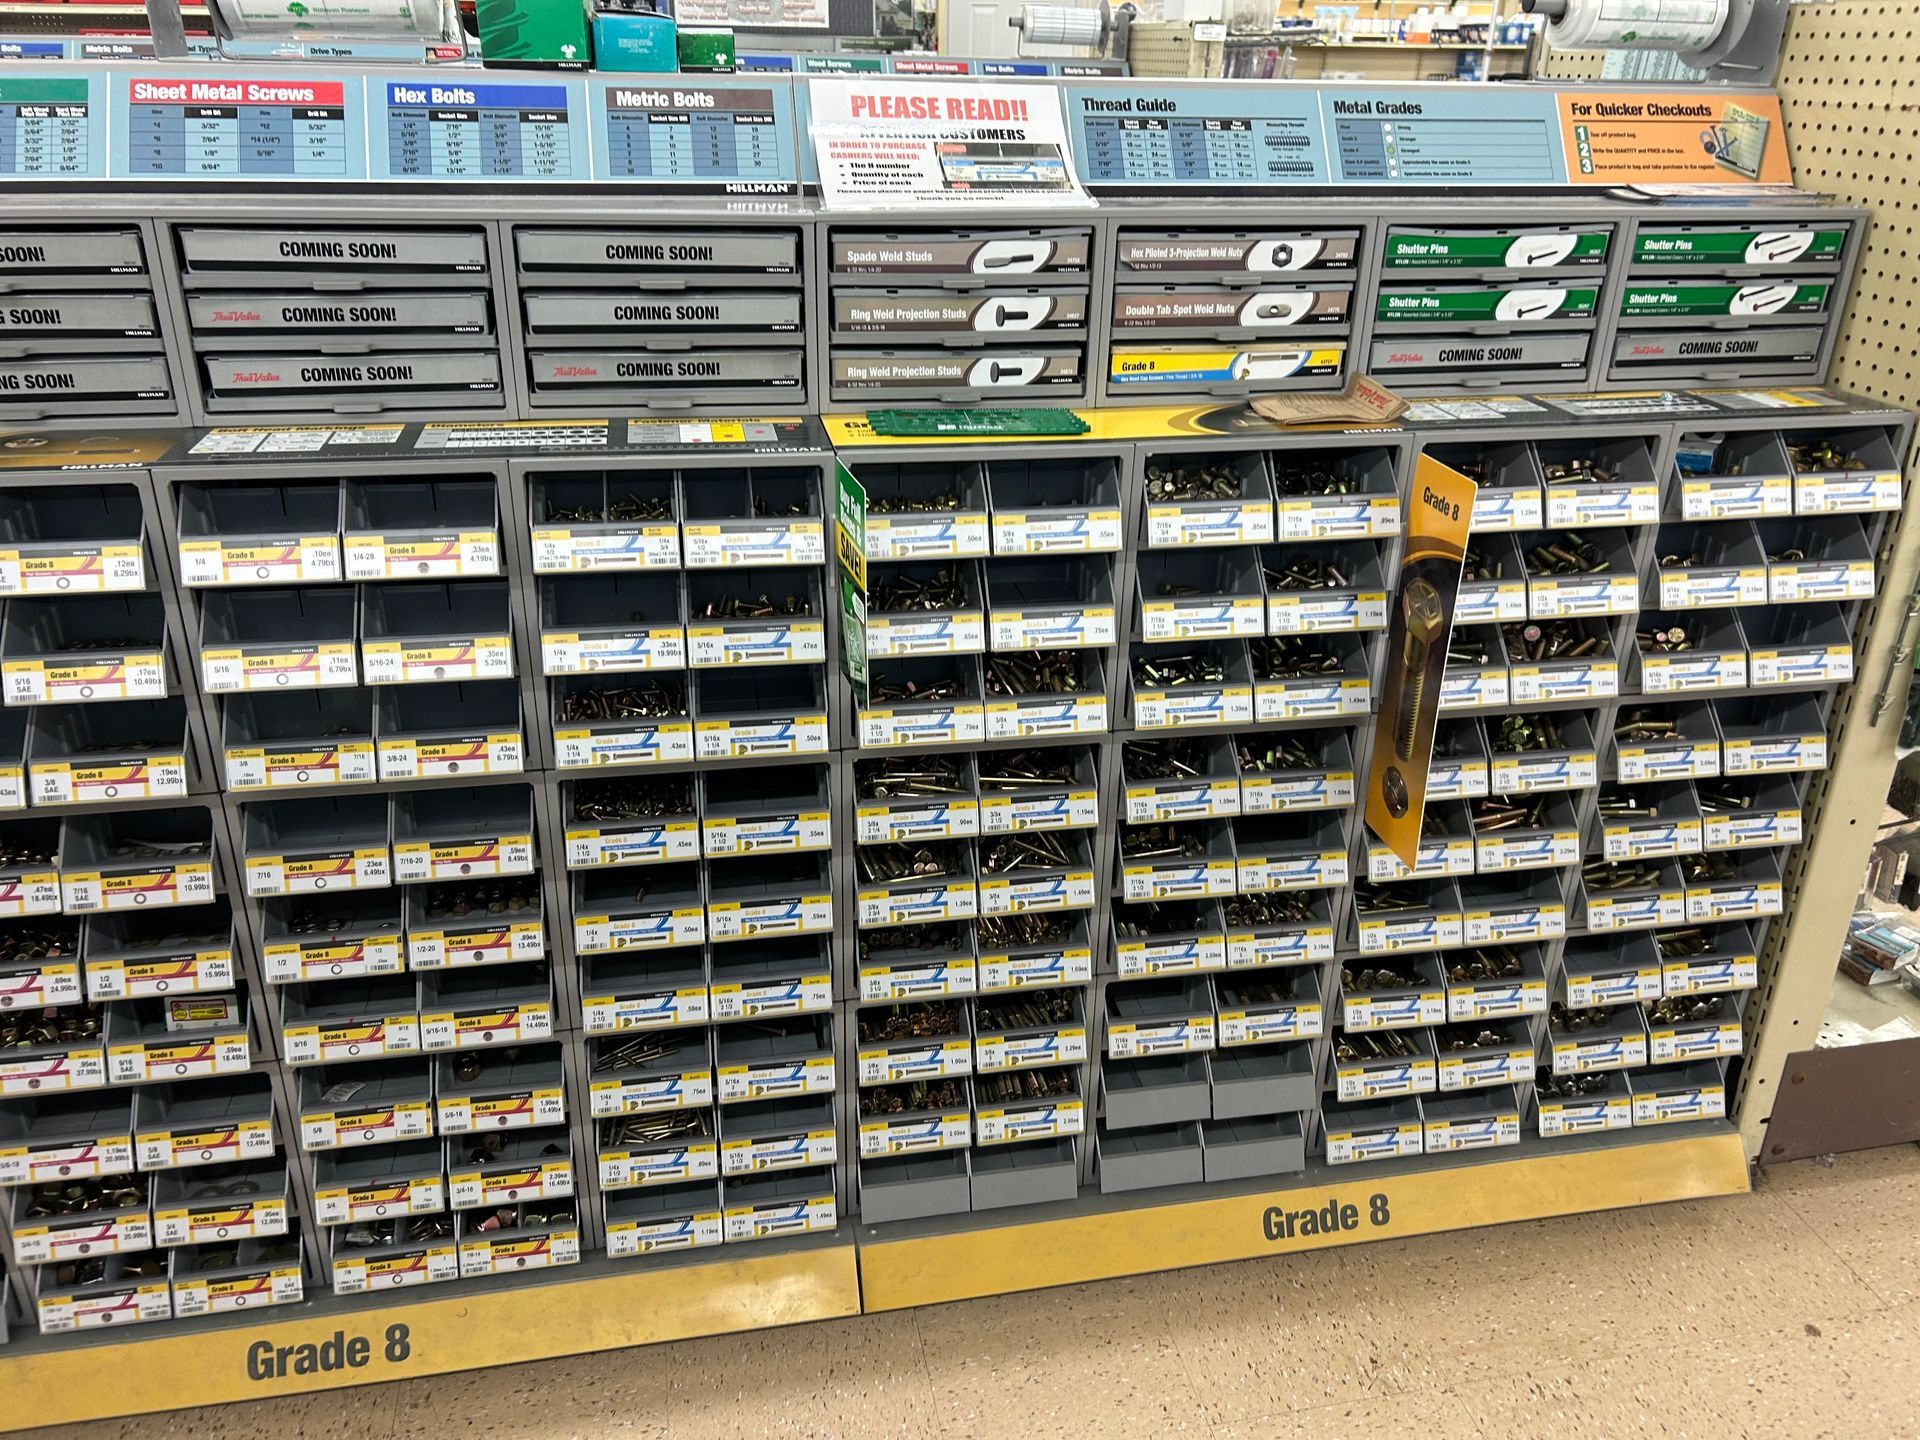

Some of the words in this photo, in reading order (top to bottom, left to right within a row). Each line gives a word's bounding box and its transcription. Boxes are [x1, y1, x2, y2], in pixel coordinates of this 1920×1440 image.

[310, 47, 329, 55] Drive
[331, 48, 352, 57] Types
[807, 59, 824, 68] Wood
[826, 60, 852, 69] Screws
[134, 83, 187, 100] Sheet
[192, 84, 243, 101] Metal
[247, 84, 315, 101] Screws
[394, 87, 427, 104] Hex
[431, 88, 476, 105] Bolts
[616, 90, 669, 107] Metric
[673, 92, 715, 108] Bolts
[851, 95, 942, 119] PLEASE
[946, 98, 1029, 122] READ!!
[1081, 97, 1132, 112] Thread
[1136, 98, 1177, 113] Guide
[1333, 100, 1372, 114] Metal
[1376, 101, 1423, 115] Grades
[1571, 102, 1592, 115] For
[1595, 103, 1644, 117] Quicker
[1647, 103, 1712, 117] Checkouts
[1577, 126, 1586, 141] 1
[829, 141, 838, 149] IN
[840, 141, 868, 149] ORDER
[870, 142, 881, 150] TO
[882, 142, 928, 150] PURCHASE
[1579, 143, 1589, 157] 2
[1582, 159, 1592, 174] 3
[726, 183, 789, 193] HILLMAN
[279, 241, 345, 257] COMING
[348, 242, 397, 259] SOON!
[1397, 244, 1429, 255] Shutter
[1430, 244, 1448, 255] Pins
[1644, 240, 1675, 251] Shutter
[1675, 240, 1693, 251] Pins
[606, 244, 664, 260] COMING
[668, 245, 713, 261] SOON!
[847, 251, 878, 263] Spade
[879, 251, 911, 262] Weld
[912, 250, 933, 262] Studs
[1131, 247, 1148, 259] Hex
[1149, 247, 1168, 259] Piloted
[1169, 247, 1210, 259] 3-Projection
[1210, 247, 1227, 258] Weld
[1228, 247, 1243, 258] Nuts
[1389, 297, 1420, 308] Shutter
[1421, 297, 1440, 308] Pins
[1629, 293, 1659, 304] Shutter
[1660, 293, 1677, 304] Pins
[282, 307, 345, 322] COMING
[348, 307, 397, 322] SOON!
[614, 306, 672, 320] COMING
[676, 305, 720, 320] SOON!
[851, 309, 871, 322] Ring
[872, 309, 895, 320] Weld
[896, 308, 941, 321] Projection
[942, 308, 967, 319] Studs
[1125, 305, 1155, 316] Double
[1156, 304, 1172, 315] Tab
[1173, 304, 1192, 316] Spot
[1193, 304, 1214, 315] Weld
[1215, 303, 1235, 315] Nuts
[11, 309, 62, 325] SOON!
[1678, 342, 1723, 355] COMING
[1724, 340, 1759, 354] SOON!
[1438, 349, 1484, 362] COMING
[1487, 348, 1523, 361] SOON!
[616, 362, 673, 377] COMING
[677, 362, 720, 376] SOON!
[1122, 361, 1147, 372] Grade
[1149, 361, 1155, 371] 8
[301, 367, 363, 382] COMING
[366, 366, 413, 381] SOON!
[847, 366, 867, 379] Ring
[868, 366, 890, 378] Weld
[891, 366, 937, 379] Projection
[937, 366, 962, 376] Studs
[25, 373, 75, 389] SOON!
[1423, 486, 1451, 516] Grade
[1452, 505, 1460, 521] 8
[227, 551, 247, 560] Grade
[249, 552, 255, 560] 8
[312, 549, 331, 558] .10ea
[471, 546, 490, 554] .33ea
[353, 552, 375, 562] 1/4-28
[470, 554, 493, 563] 4.19bx
[840, 531, 862, 582] SAVE!
[25, 560, 47, 570] Grade
[48, 560, 54, 569] 8
[114, 559, 135, 568] .12ea
[194, 558, 206, 567] 1/4
[311, 558, 335, 568] 4.79bx
[697, 641, 714, 649] 5/16x
[801, 642, 818, 650] .47ea
[369, 658, 395, 667] 5/16-24
[213, 665, 230, 674] 5/16
[328, 665, 352, 673] 6.79bx
[50, 670, 72, 680] Grade
[72, 670, 78, 679] 8
[15, 678, 31, 686] 5/16
[17, 685, 32, 693] SAE
[386, 754, 408, 762] 3/8-24
[496, 753, 518, 761] 6.79bx
[159, 768, 178, 777] .19ea
[156, 776, 184, 785] 12.99bx
[43, 786, 59, 794] SAE
[399, 856, 423, 865] 7/16-20
[256, 871, 272, 880] 7/16
[72, 887, 89, 895] 7/16
[75, 894, 90, 902] SAE
[276, 958, 287, 967] 1/2
[1263, 1199, 1359, 1241] Grade
[1369, 1193, 1391, 1226] 8
[247, 1330, 371, 1381] Grade
[384, 1322, 411, 1362] 8
